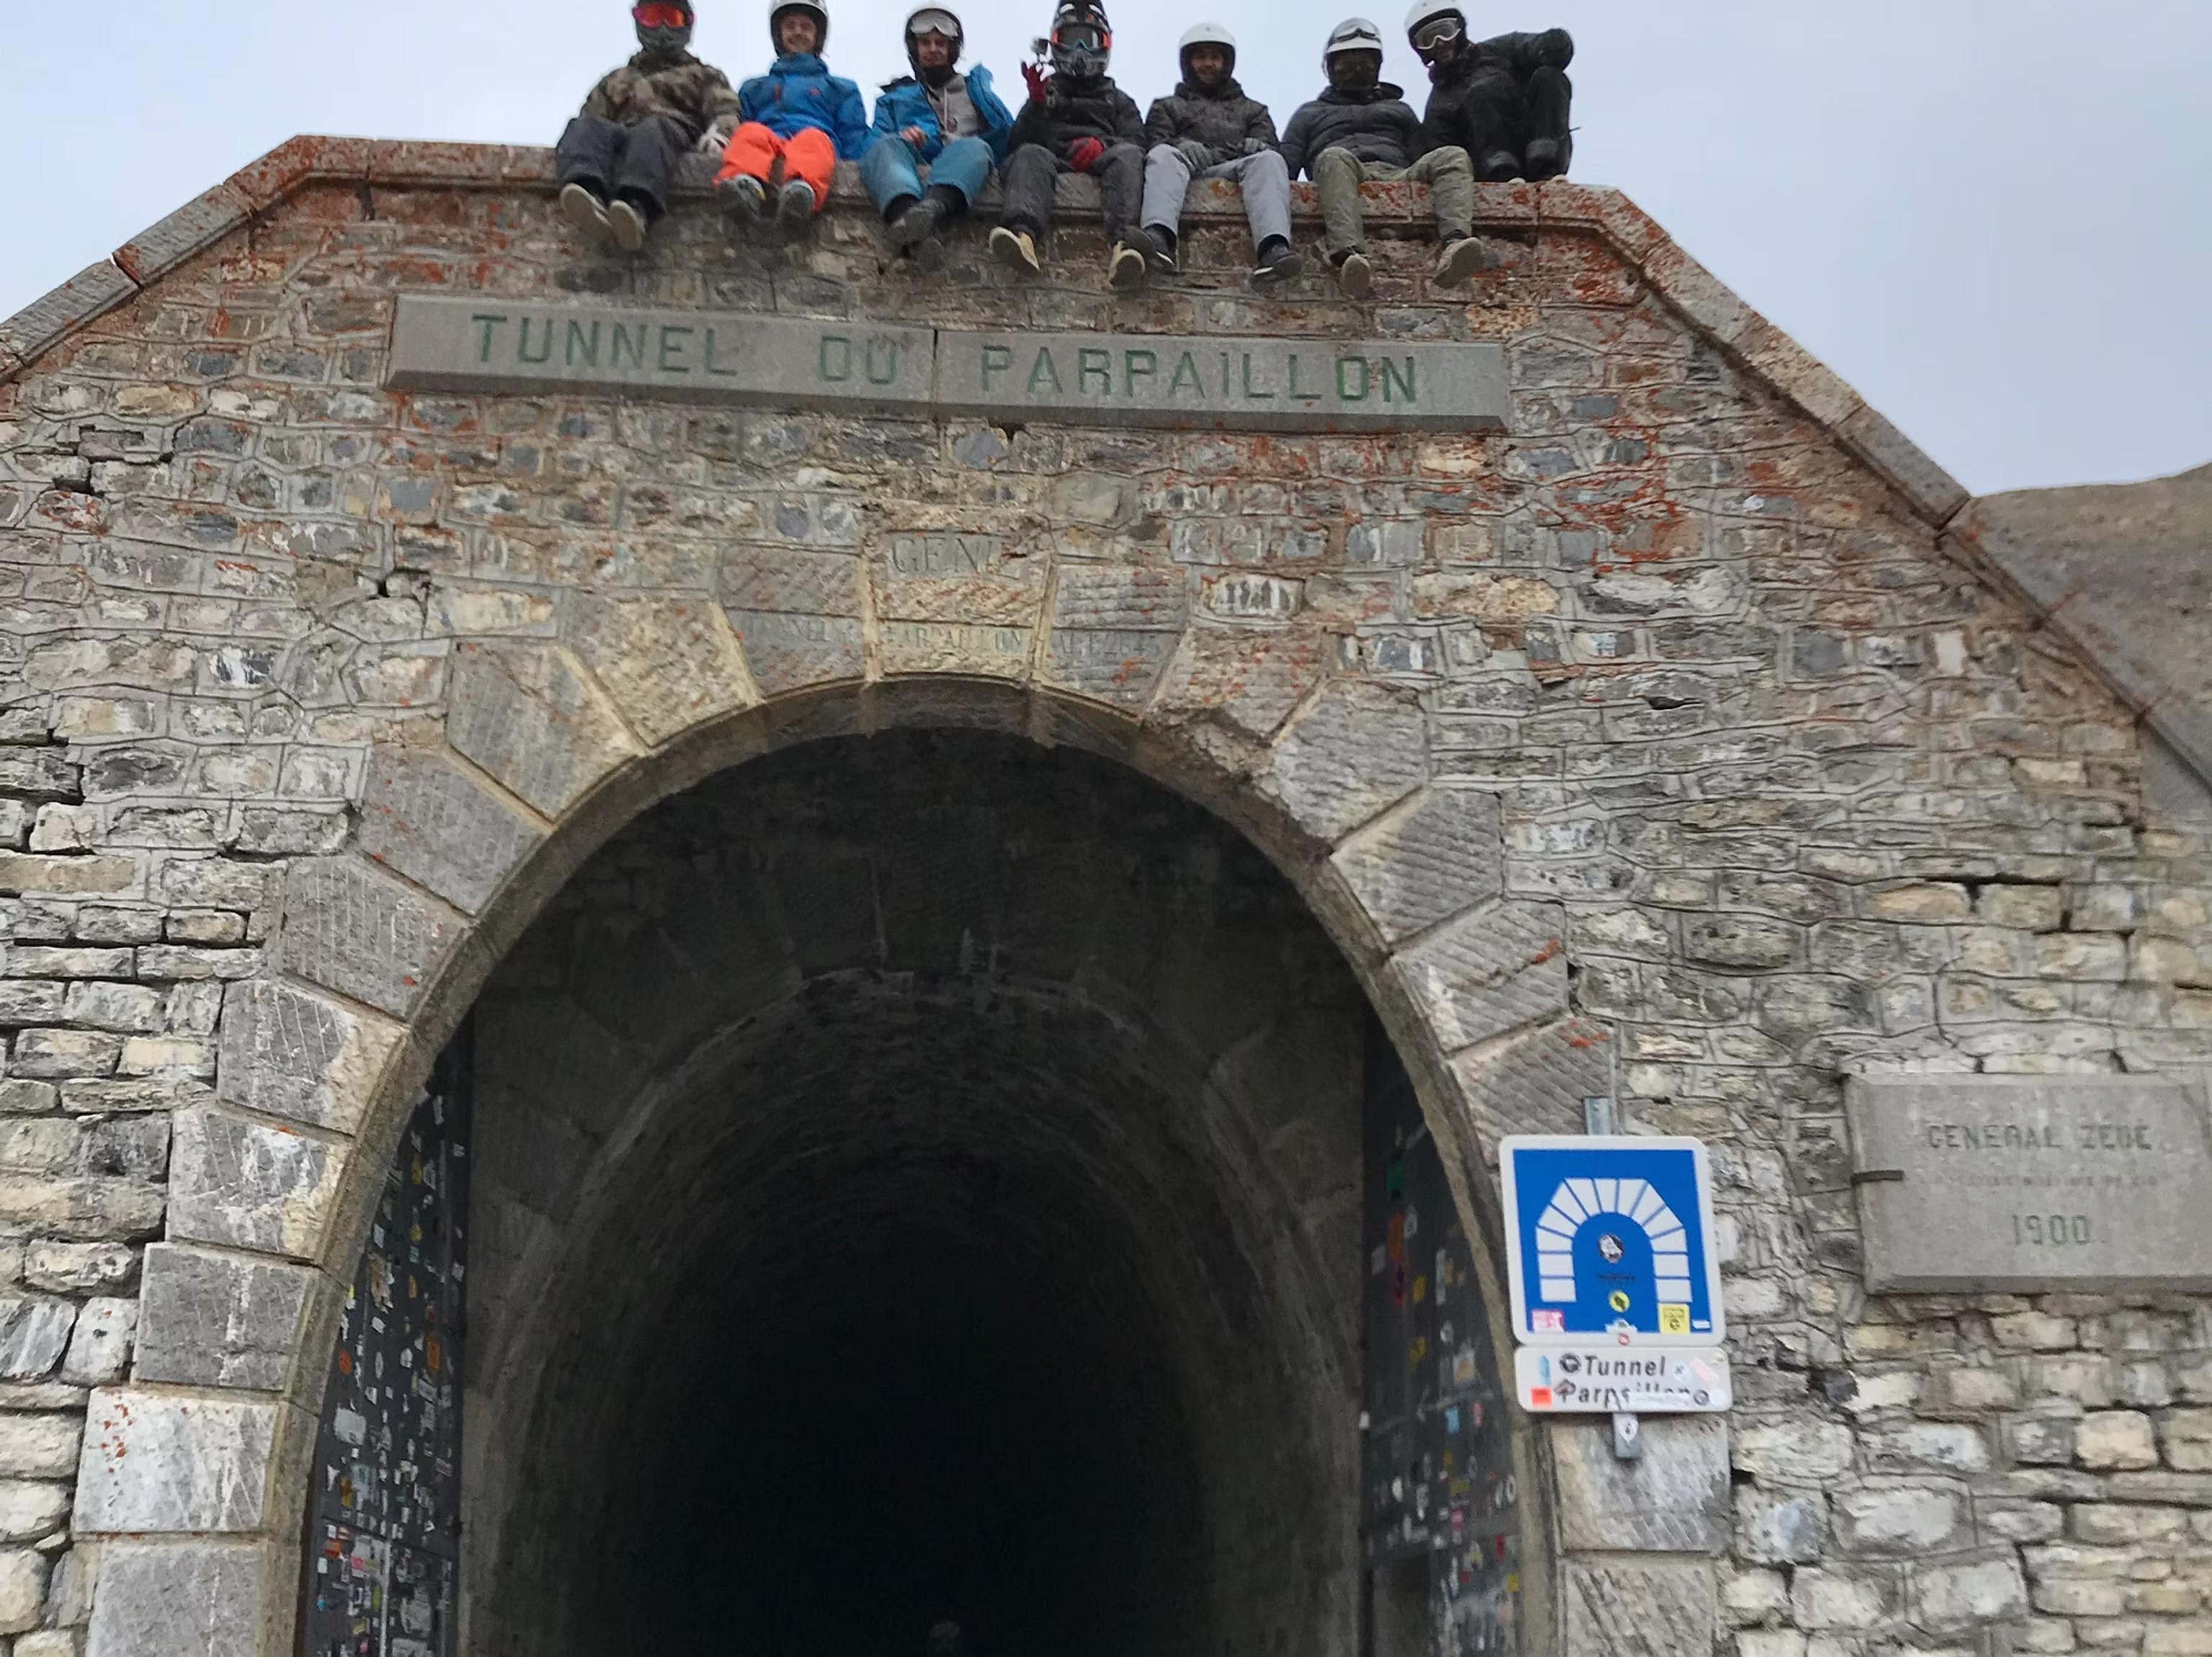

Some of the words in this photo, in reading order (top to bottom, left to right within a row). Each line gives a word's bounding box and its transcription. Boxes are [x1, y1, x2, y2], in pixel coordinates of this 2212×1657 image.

[472, 312, 739, 377] TUNNEL
[980, 344, 1418, 404] PARPAILLON
[1927, 1123, 2064, 1151] GENERAL
[2012, 1214, 2092, 1246] 1900
[1584, 1354, 1667, 1377] Tunnel
